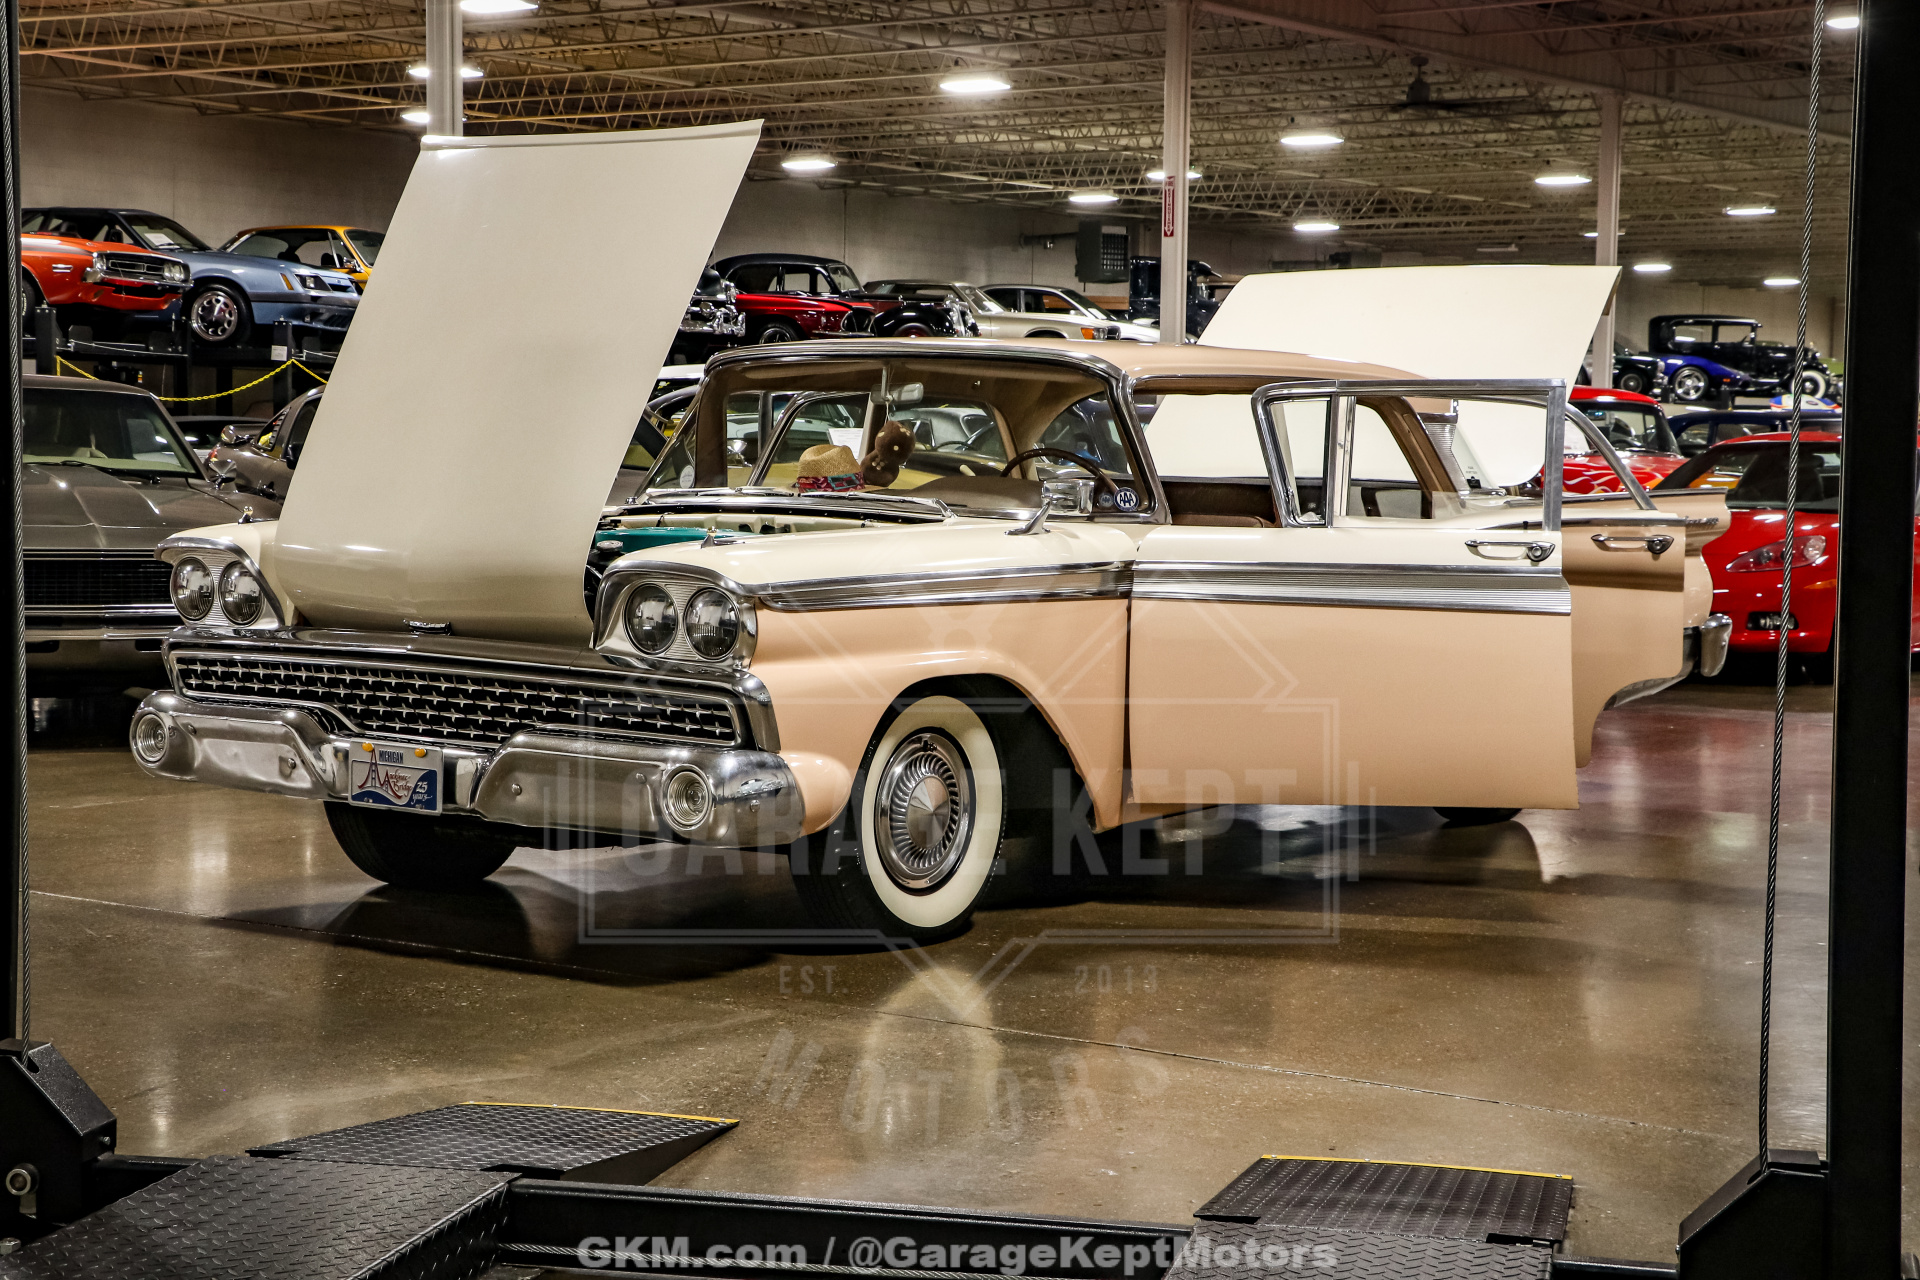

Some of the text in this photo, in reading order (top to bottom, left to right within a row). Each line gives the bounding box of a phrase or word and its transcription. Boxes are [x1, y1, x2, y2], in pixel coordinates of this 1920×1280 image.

[1119, 491, 1135, 507] AAA
[379, 749, 404, 764] MICHIGAN
[392, 780, 413, 797] Bridge
[416, 781, 428, 793] 25
[411, 793, 432, 805] years
